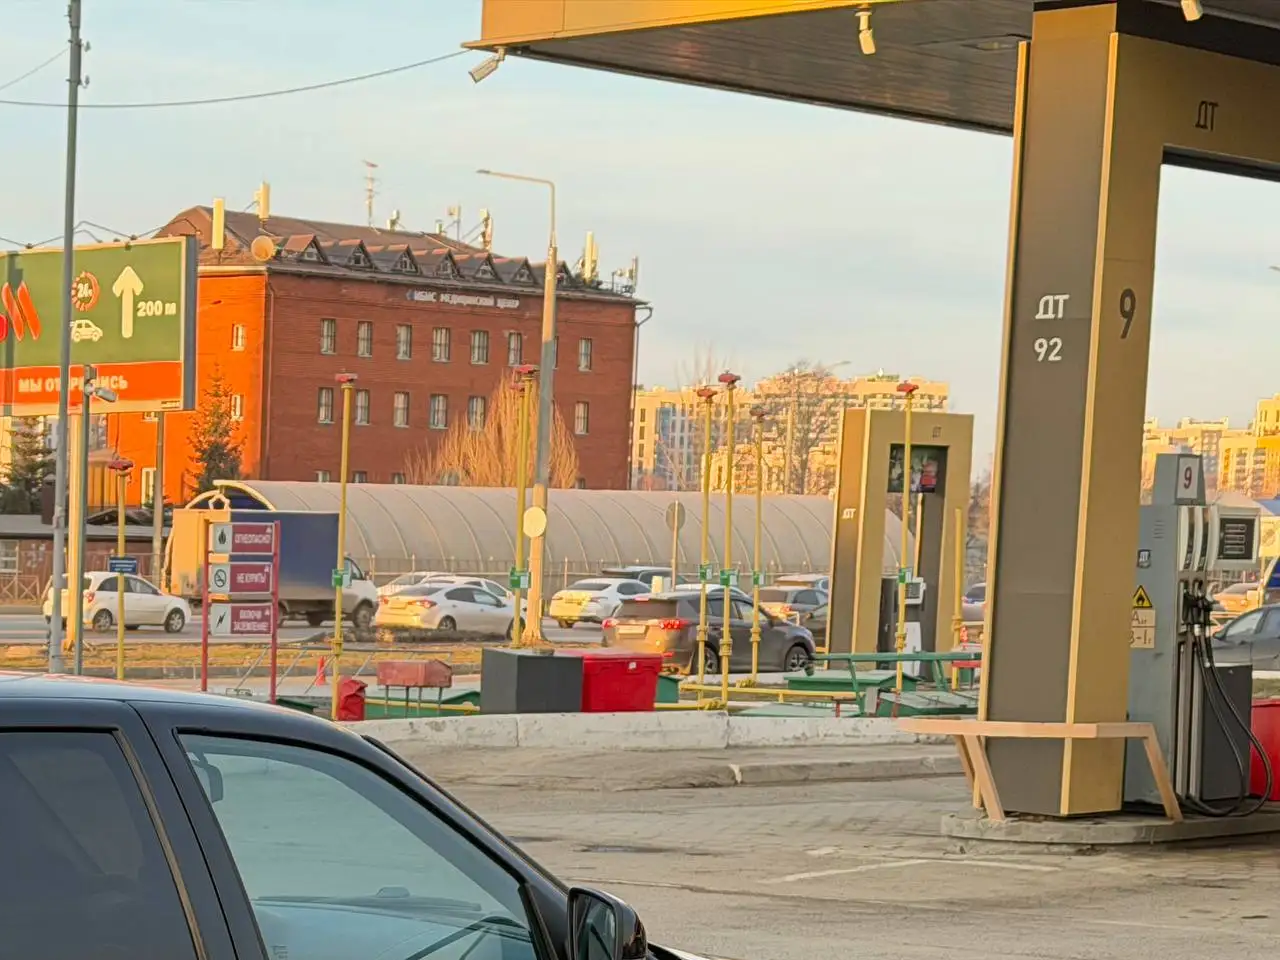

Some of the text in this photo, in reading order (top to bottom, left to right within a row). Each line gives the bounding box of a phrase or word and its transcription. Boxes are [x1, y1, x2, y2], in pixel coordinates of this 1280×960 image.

[1195, 101, 1218, 131] ДТ
[137, 301, 163, 317] 200
[1035, 294, 1070, 320] ДТ
[1120, 288, 1136, 339] 9
[1033, 337, 1063, 362] 92
[19, 378, 42, 392] МЫ
[1183, 466, 1192, 489] 9
[842, 508, 857, 519] ДТ
